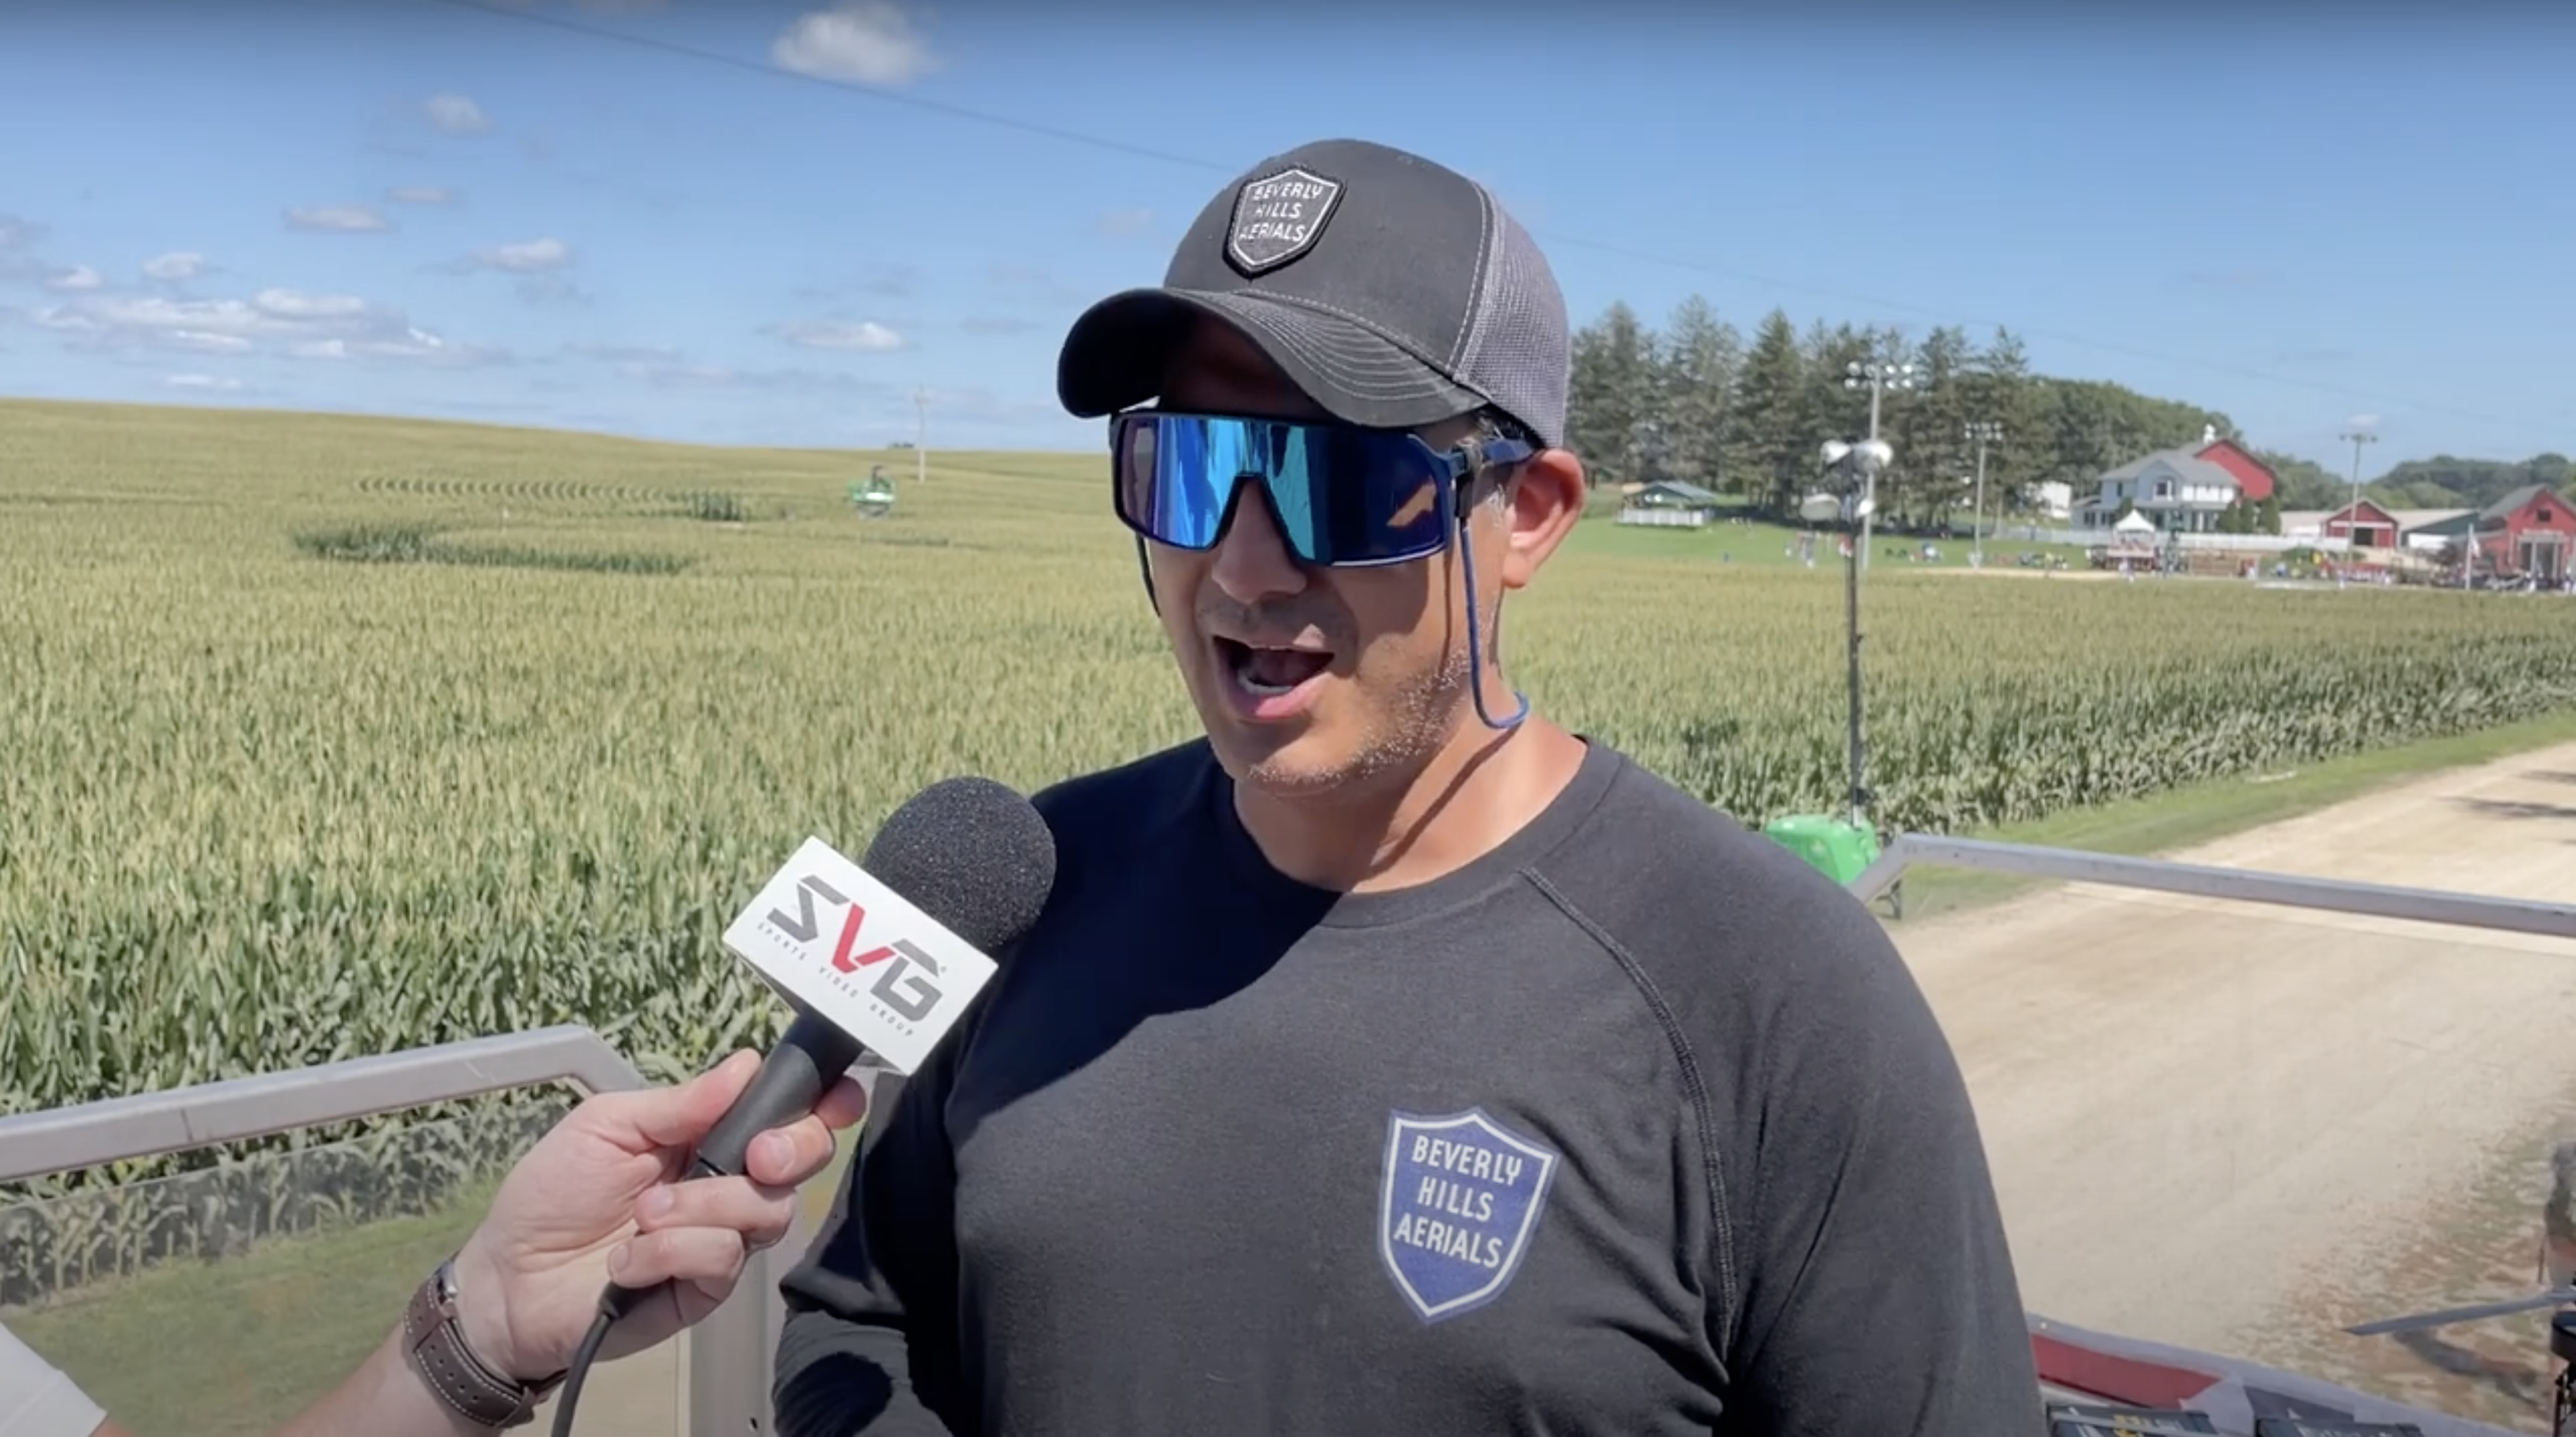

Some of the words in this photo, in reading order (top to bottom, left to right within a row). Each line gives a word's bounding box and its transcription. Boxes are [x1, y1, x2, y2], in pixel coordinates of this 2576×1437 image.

[1253, 182, 1323, 201] BEVERLY
[1256, 202, 1302, 218] HILLS
[767, 875, 942, 1022] SVG
[757, 922, 807, 960] SPORTS
[819, 966, 858, 997] VIDEO
[869, 1003, 913, 1036] GROUP
[1412, 1135, 1522, 1186] BEVERLY
[1417, 1176, 1493, 1222] HILLS
[1393, 1212, 1503, 1267] AERIALS
